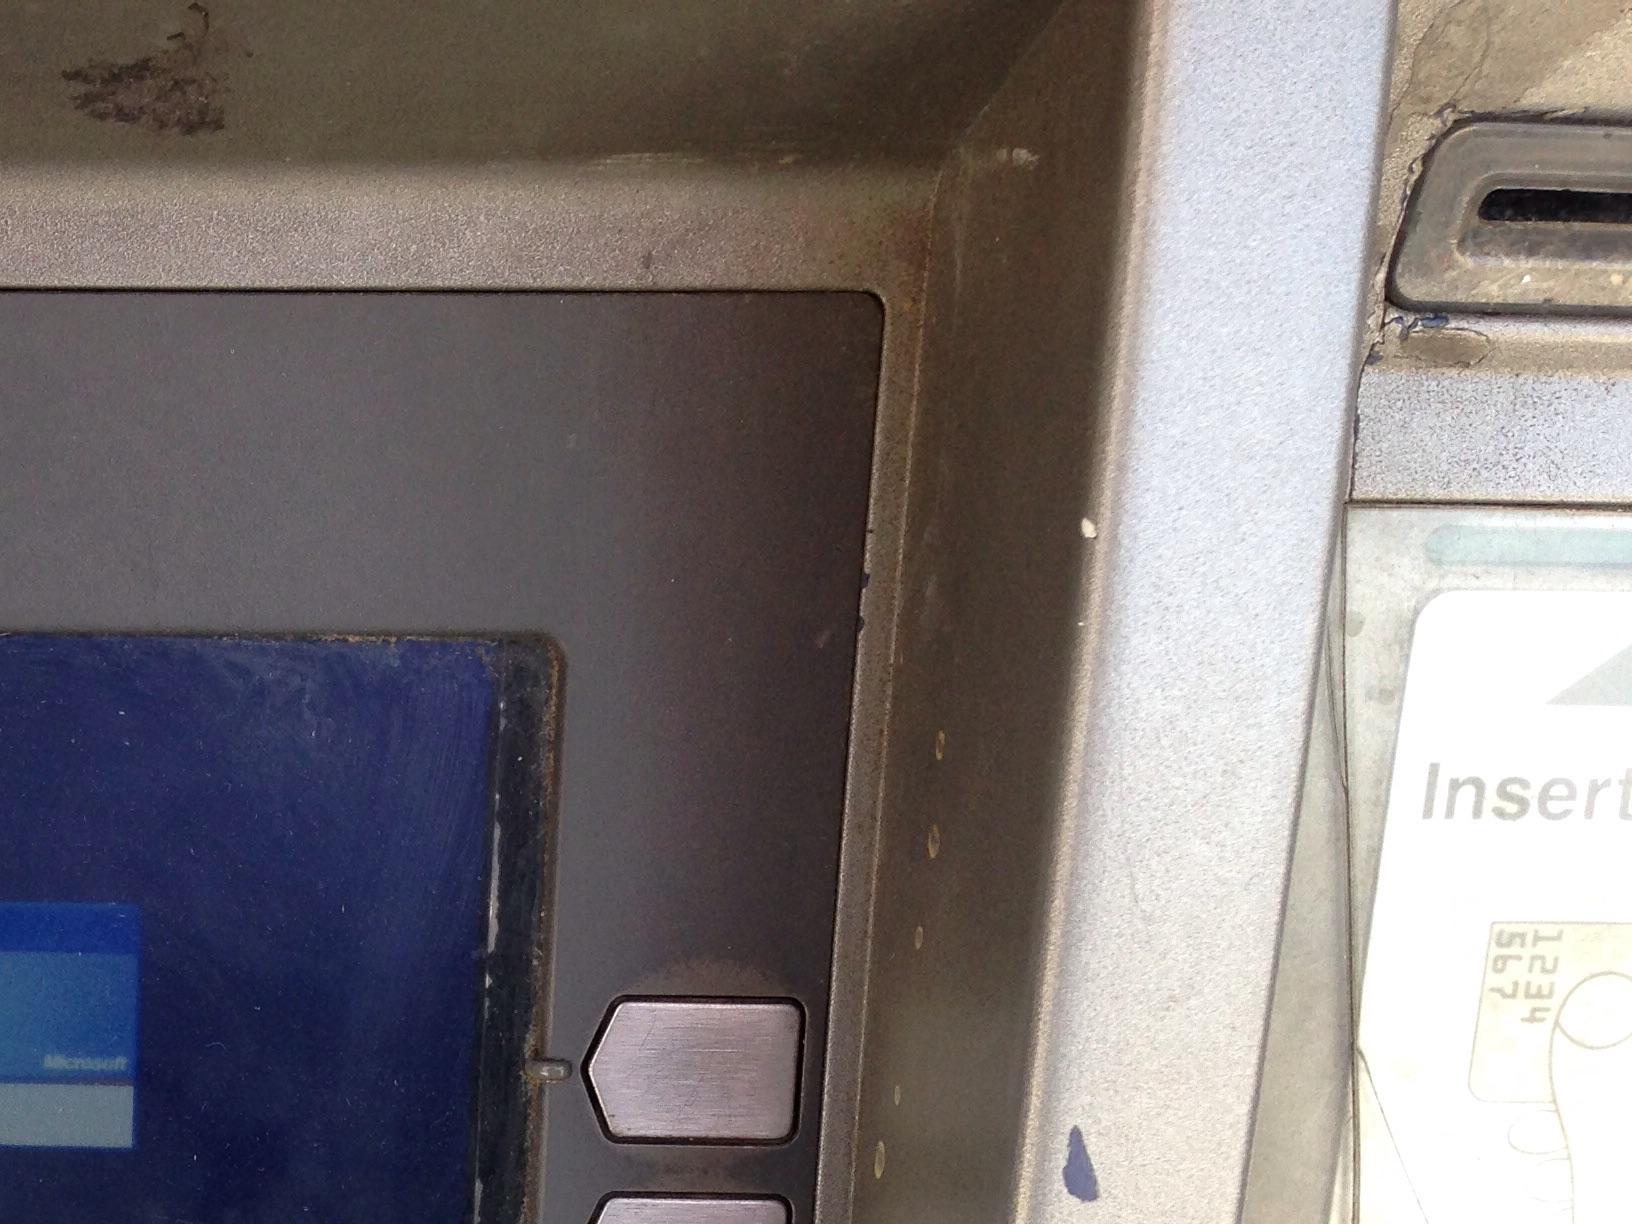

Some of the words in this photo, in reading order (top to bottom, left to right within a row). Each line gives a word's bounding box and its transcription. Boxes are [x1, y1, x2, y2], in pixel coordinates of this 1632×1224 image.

[1422, 762, 1632, 822] Insert
[1488, 929, 1528, 1000] 567
[1520, 929, 1564, 1024] 1234
[43, 1053, 129, 1071] Microsoft
